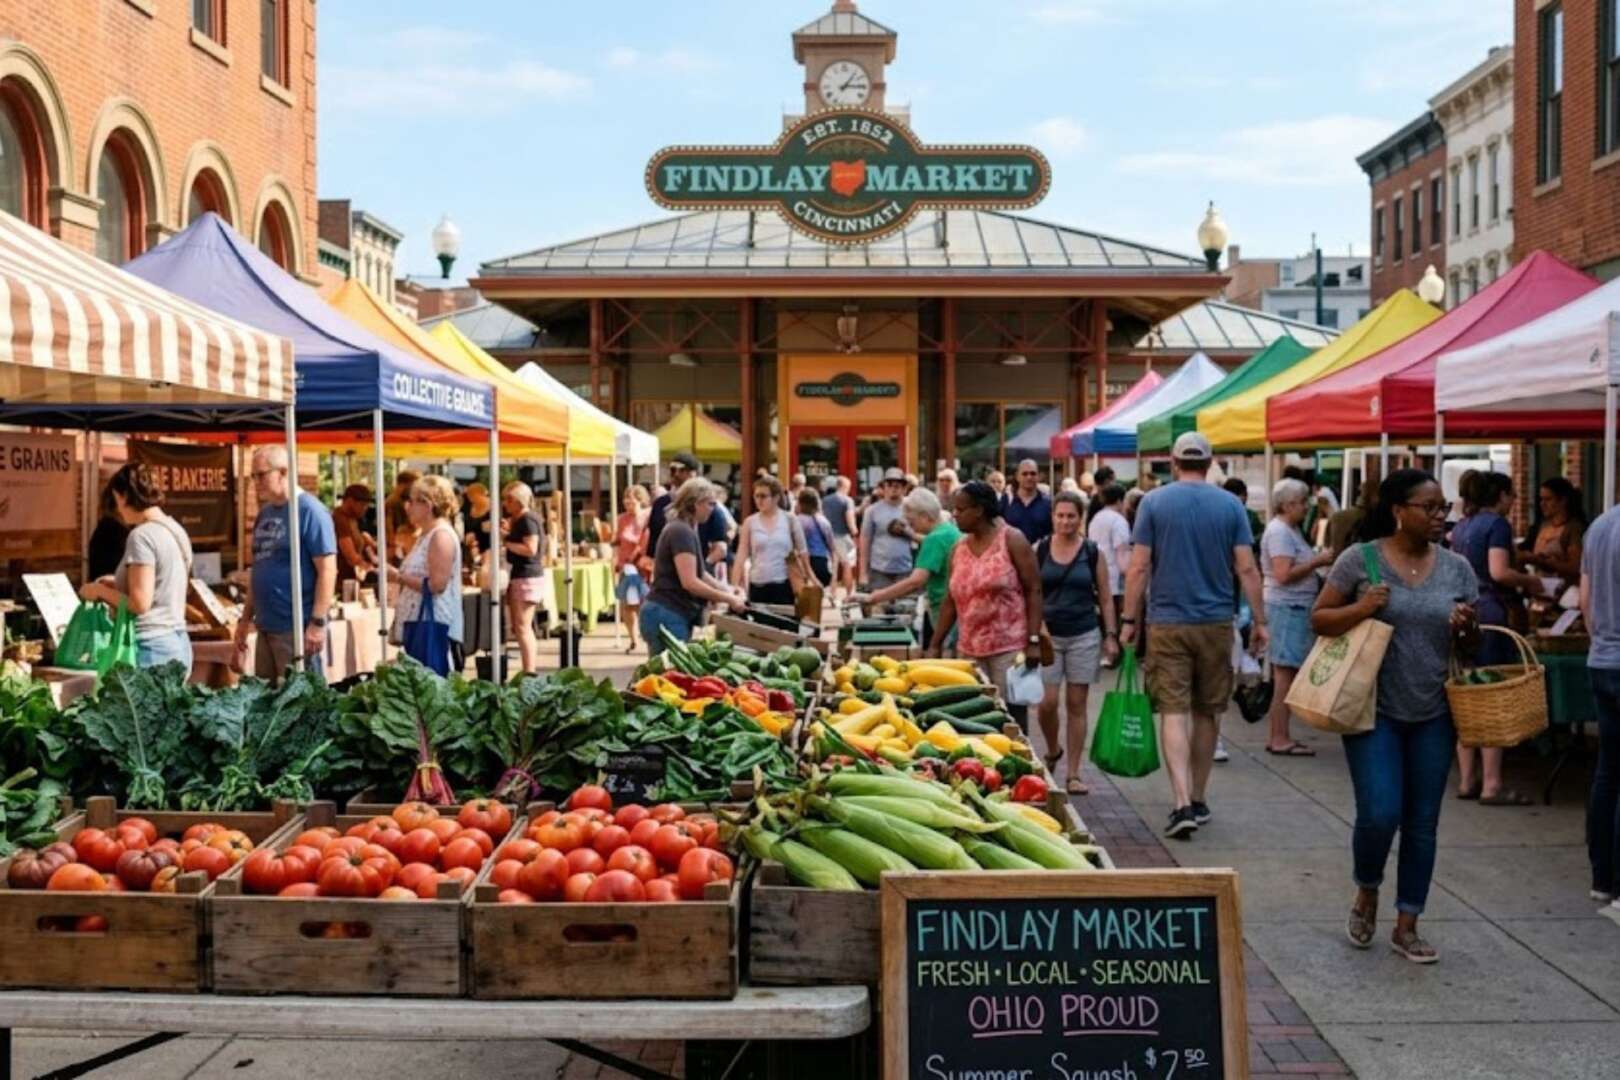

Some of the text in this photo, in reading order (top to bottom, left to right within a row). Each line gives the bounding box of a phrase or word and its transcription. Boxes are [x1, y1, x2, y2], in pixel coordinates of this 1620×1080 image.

[850, 120, 894, 145] 1852
[663, 165, 1032, 192] FINDLAY MARKET
[10, 447, 71, 472] GRAINS
[917, 908, 1208, 951] FINDLAY MARKET
[917, 960, 1210, 987] FRESH LOCAL SEASONAL
[968, 994, 1160, 1029] OHIO PROUD
